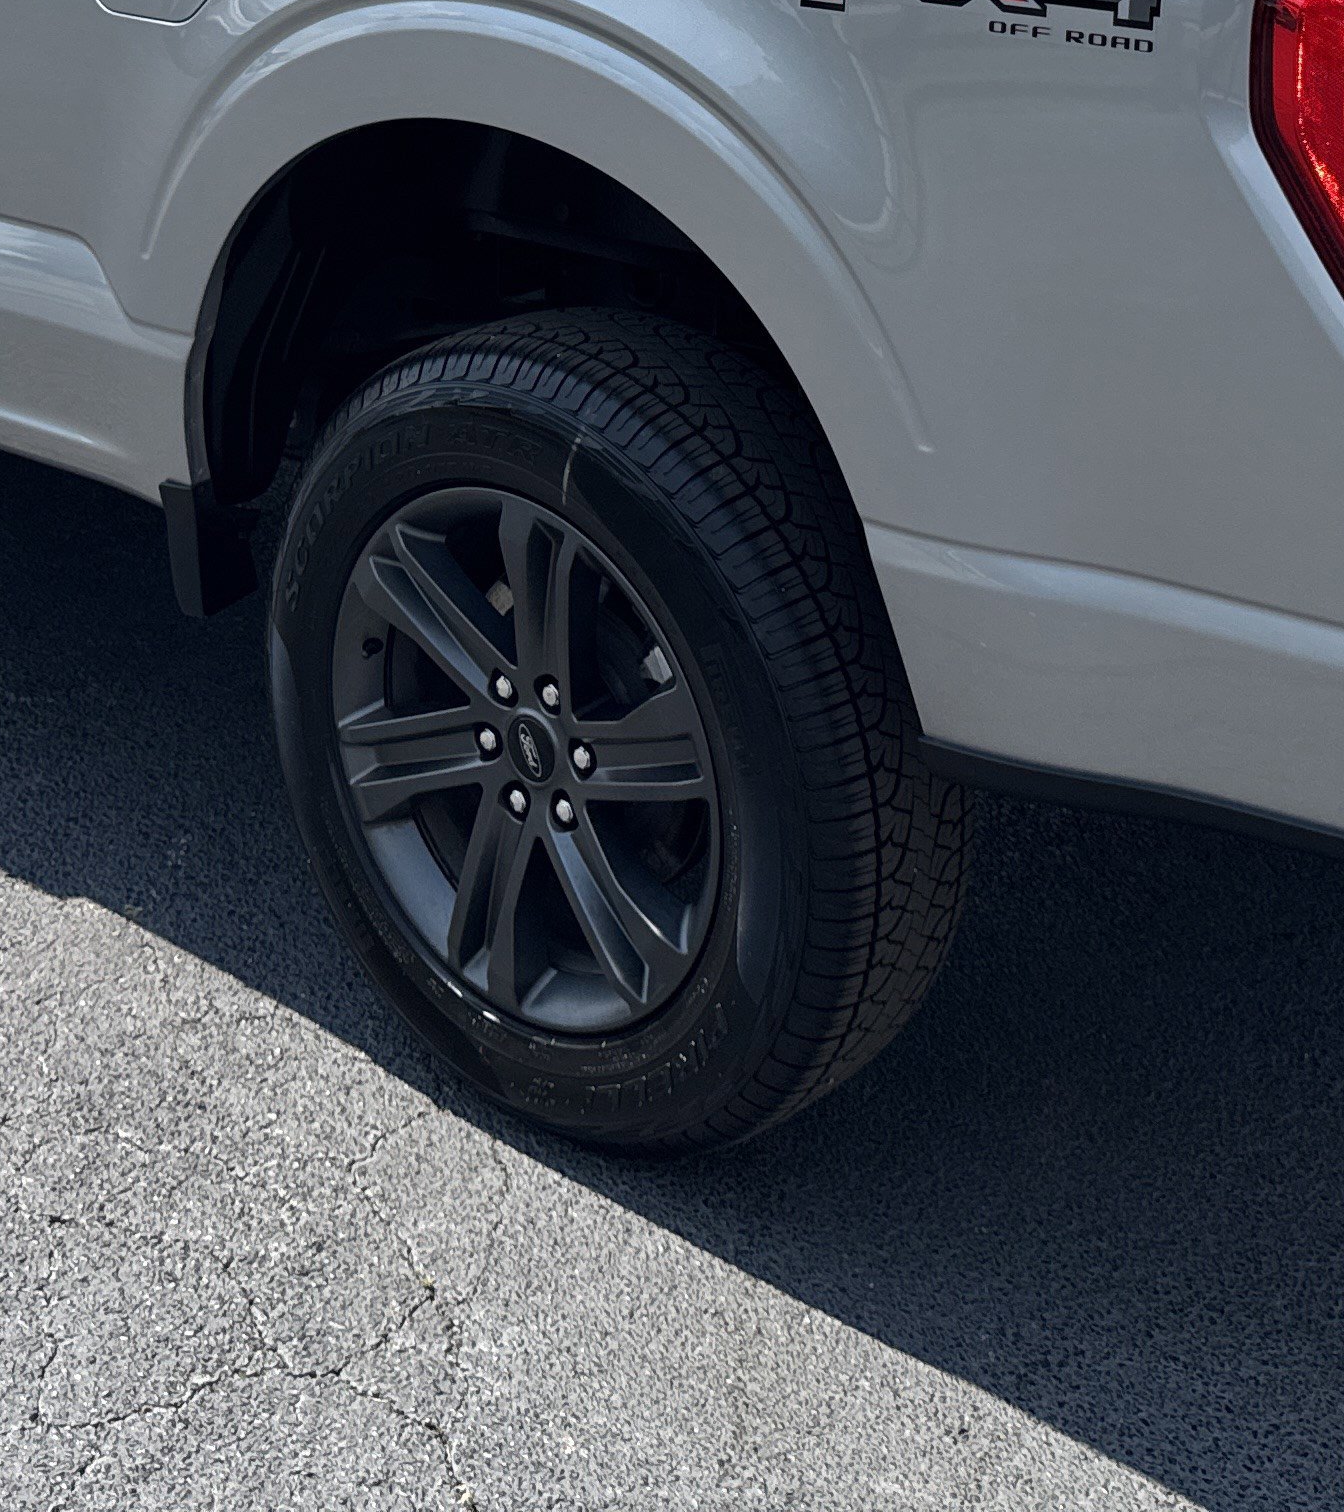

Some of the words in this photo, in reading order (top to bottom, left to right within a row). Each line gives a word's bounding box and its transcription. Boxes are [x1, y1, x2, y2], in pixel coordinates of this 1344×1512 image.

[988, 20, 1052, 39] OFF
[1065, 29, 1154, 54] ROAD
[285, 421, 431, 612] SCORPION
